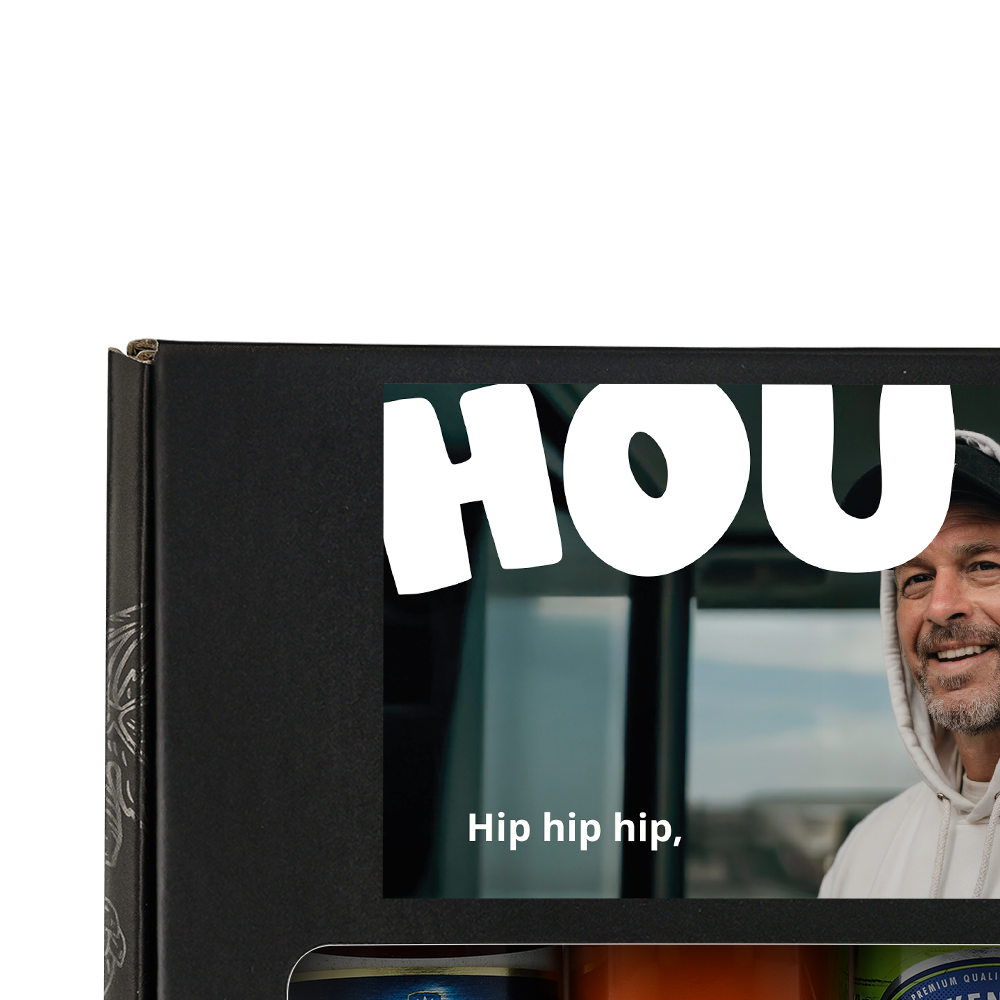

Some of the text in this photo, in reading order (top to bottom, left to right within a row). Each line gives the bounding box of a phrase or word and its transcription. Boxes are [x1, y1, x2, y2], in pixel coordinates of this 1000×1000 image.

[383, 384, 955, 594] HOU
[468, 812, 682, 850] Hip hip hip,
